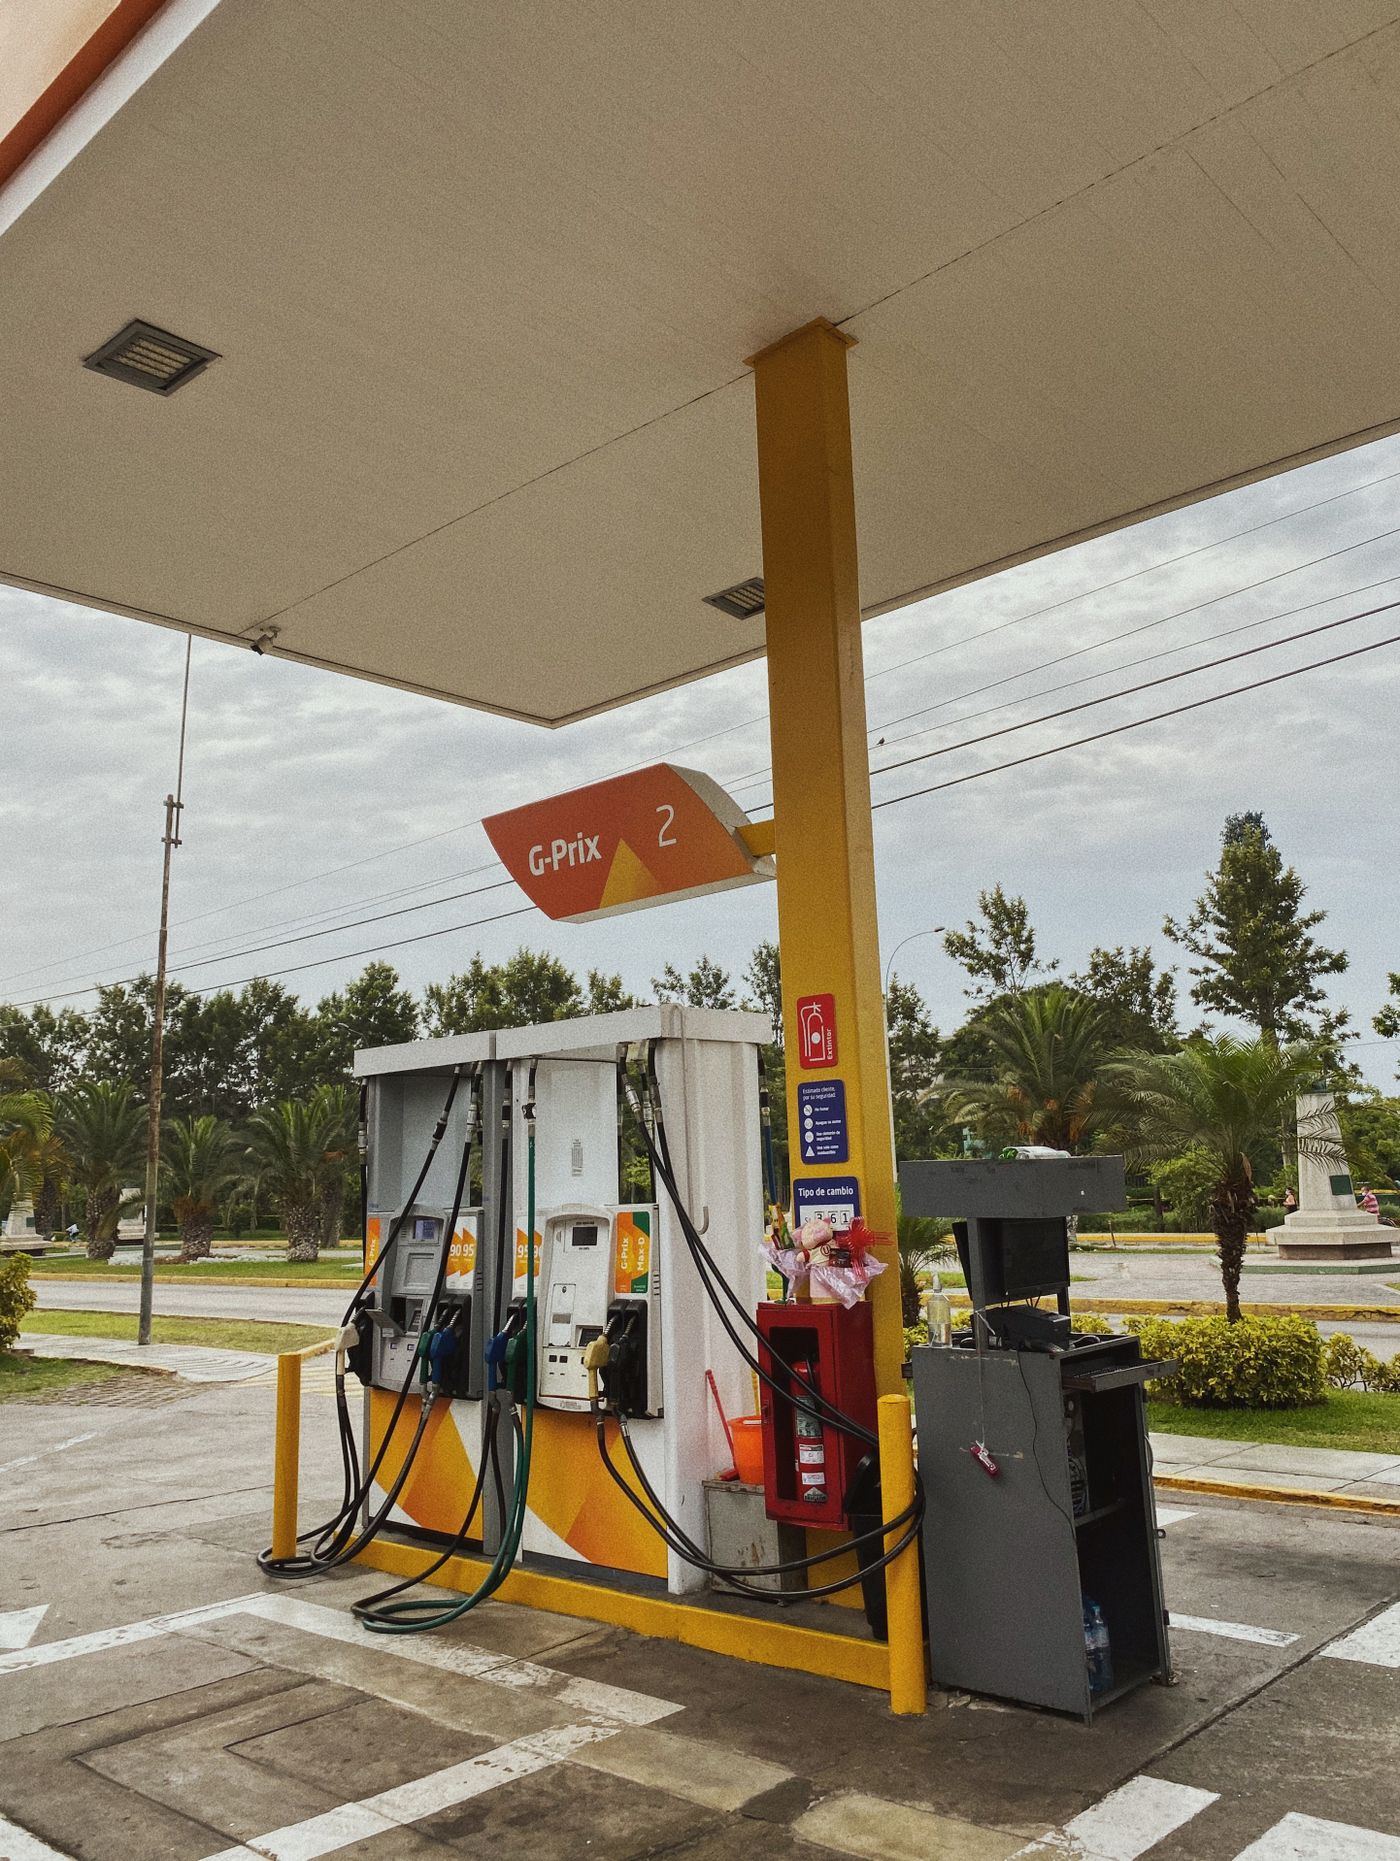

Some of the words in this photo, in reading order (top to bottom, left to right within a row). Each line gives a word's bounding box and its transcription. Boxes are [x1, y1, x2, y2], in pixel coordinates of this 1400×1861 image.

[656, 804, 677, 847] 2
[528, 831, 602, 876] G-Prix
[798, 1187, 814, 1198] Tipo
[815, 1187, 825, 1196] de
[826, 1186, 854, 1196] cambio
[450, 1244, 461, 1257] 90
[462, 1243, 474, 1257] 95
[620, 1237, 629, 1270] G-Prix
[637, 1237, 645, 1271] Max-D
